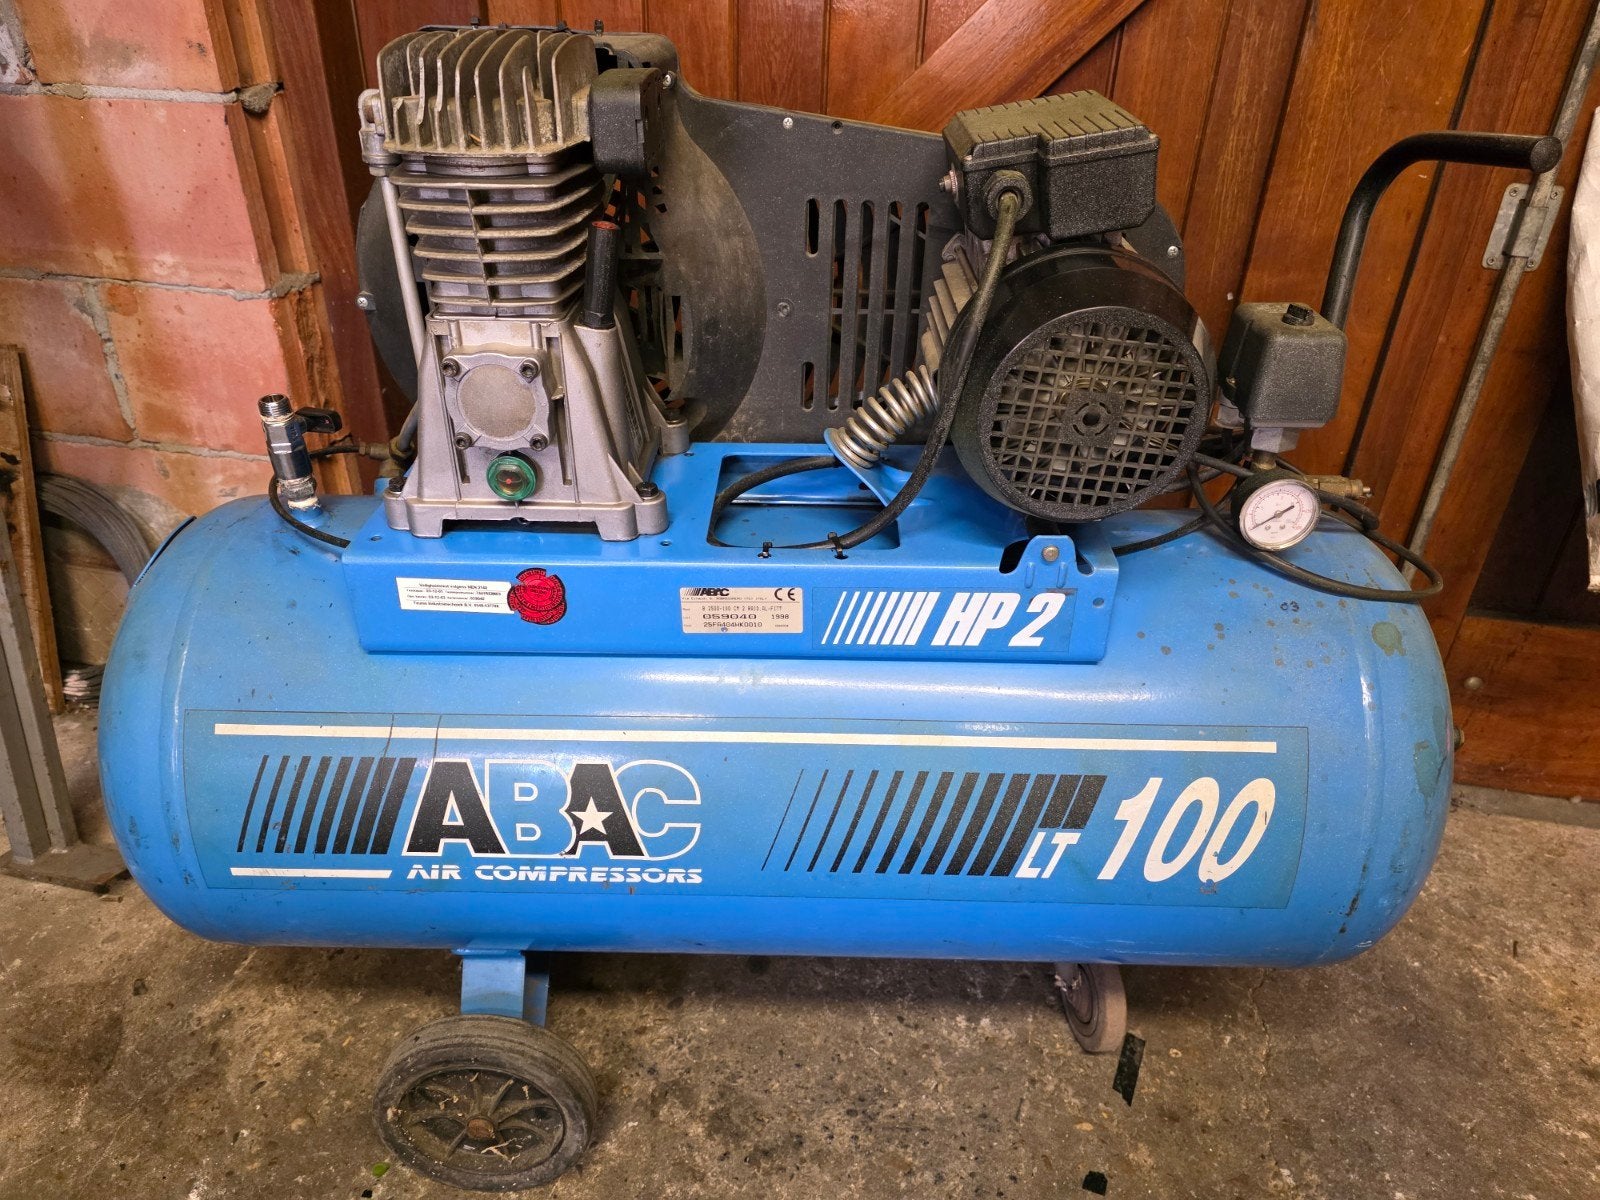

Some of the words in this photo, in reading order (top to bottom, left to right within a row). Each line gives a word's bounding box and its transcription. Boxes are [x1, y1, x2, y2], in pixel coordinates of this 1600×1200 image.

[700, 587, 729, 596] ABAC
[930, 592, 1021, 646] HP
[1008, 592, 1066, 647] 2
[401, 757, 702, 861] ABAC
[1014, 831, 1082, 879] LT
[1096, 776, 1276, 883] 100
[406, 864, 462, 880] AIR
[475, 864, 703, 884] COMPRESSORS
